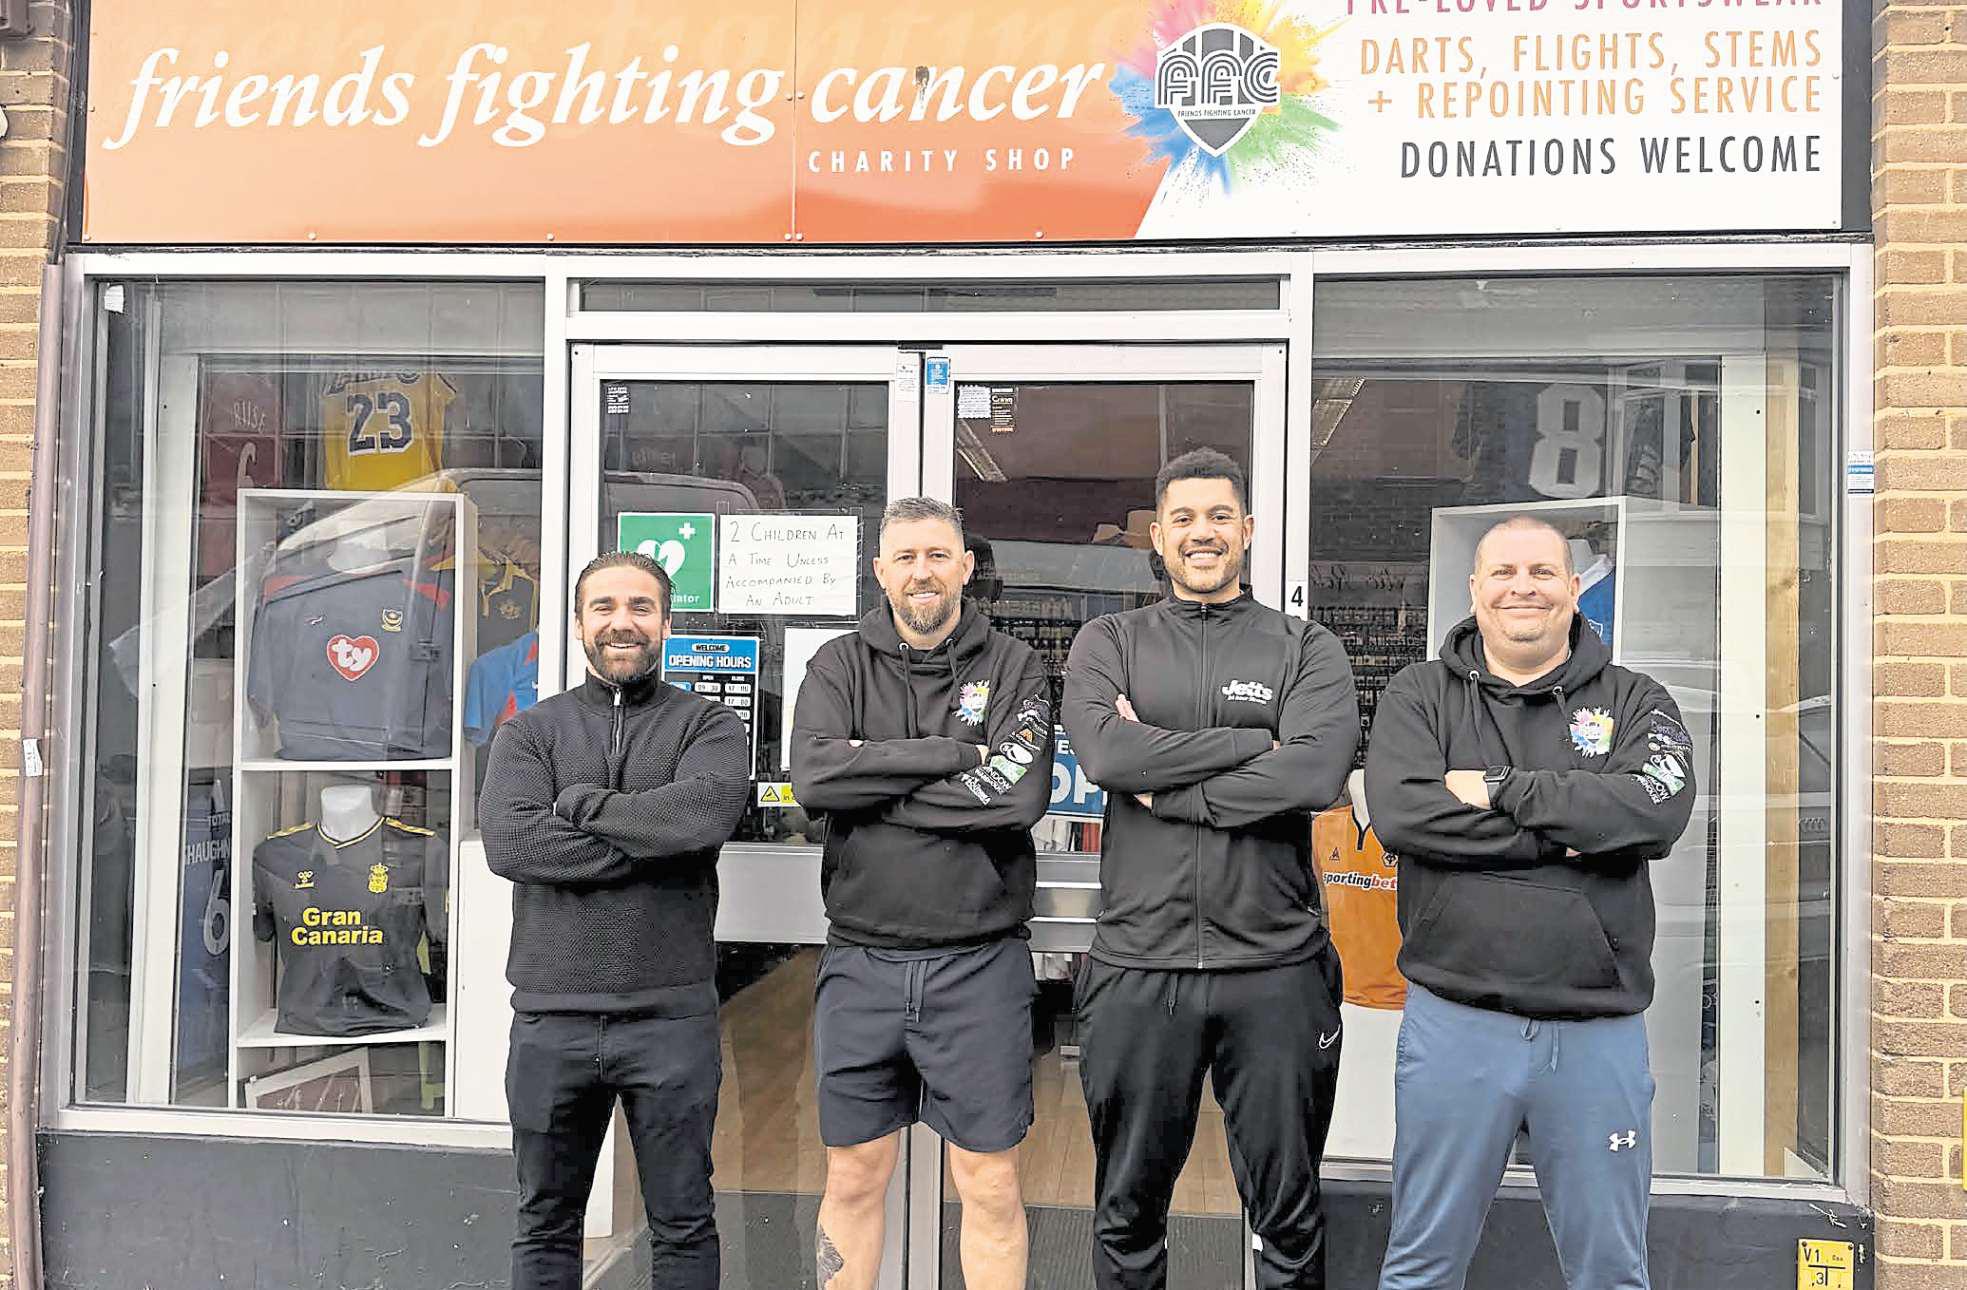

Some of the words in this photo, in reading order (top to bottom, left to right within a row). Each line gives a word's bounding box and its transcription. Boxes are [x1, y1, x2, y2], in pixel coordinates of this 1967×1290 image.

[1360, 36, 1487, 80] DARTS,
[1514, 32, 1678, 76] FLIGHTS,
[1704, 29, 1822, 69] STEMS
[103, 45, 415, 150] friends
[418, 41, 785, 148] fighting
[811, 61, 1104, 124] cancer
[1368, 90, 1393, 113] +
[1418, 76, 1645, 119] REPOINTING
[1670, 75, 1822, 113] SERVICE
[1177, 110, 1202, 118] FRIENDS
[1203, 109, 1232, 117] FIGHTING
[1233, 108, 1256, 116] CANCER
[808, 148, 959, 174] CHARITY
[986, 147, 1075, 171] SHOP
[1401, 137, 1617, 178] DONATIONS
[1640, 135, 1822, 173] WELCOME
[346, 390, 414, 456] 23
[1528, 382, 1606, 499] 8
[729, 520, 741, 543] 2
[751, 521, 817, 542] CHILDREN
[728, 552, 737, 566] A
[1290, 585, 1304, 608] 4
[332, 639, 374, 673] ty
[668, 654, 714, 668] OPENING
[716, 656, 752, 669] HOURS
[185, 838, 231, 865] HAUGHN
[1323, 872, 1397, 889] sportingbet
[203, 869, 230, 957] 6
[302, 906, 361, 927] Gran
[291, 925, 384, 946] Canaria
